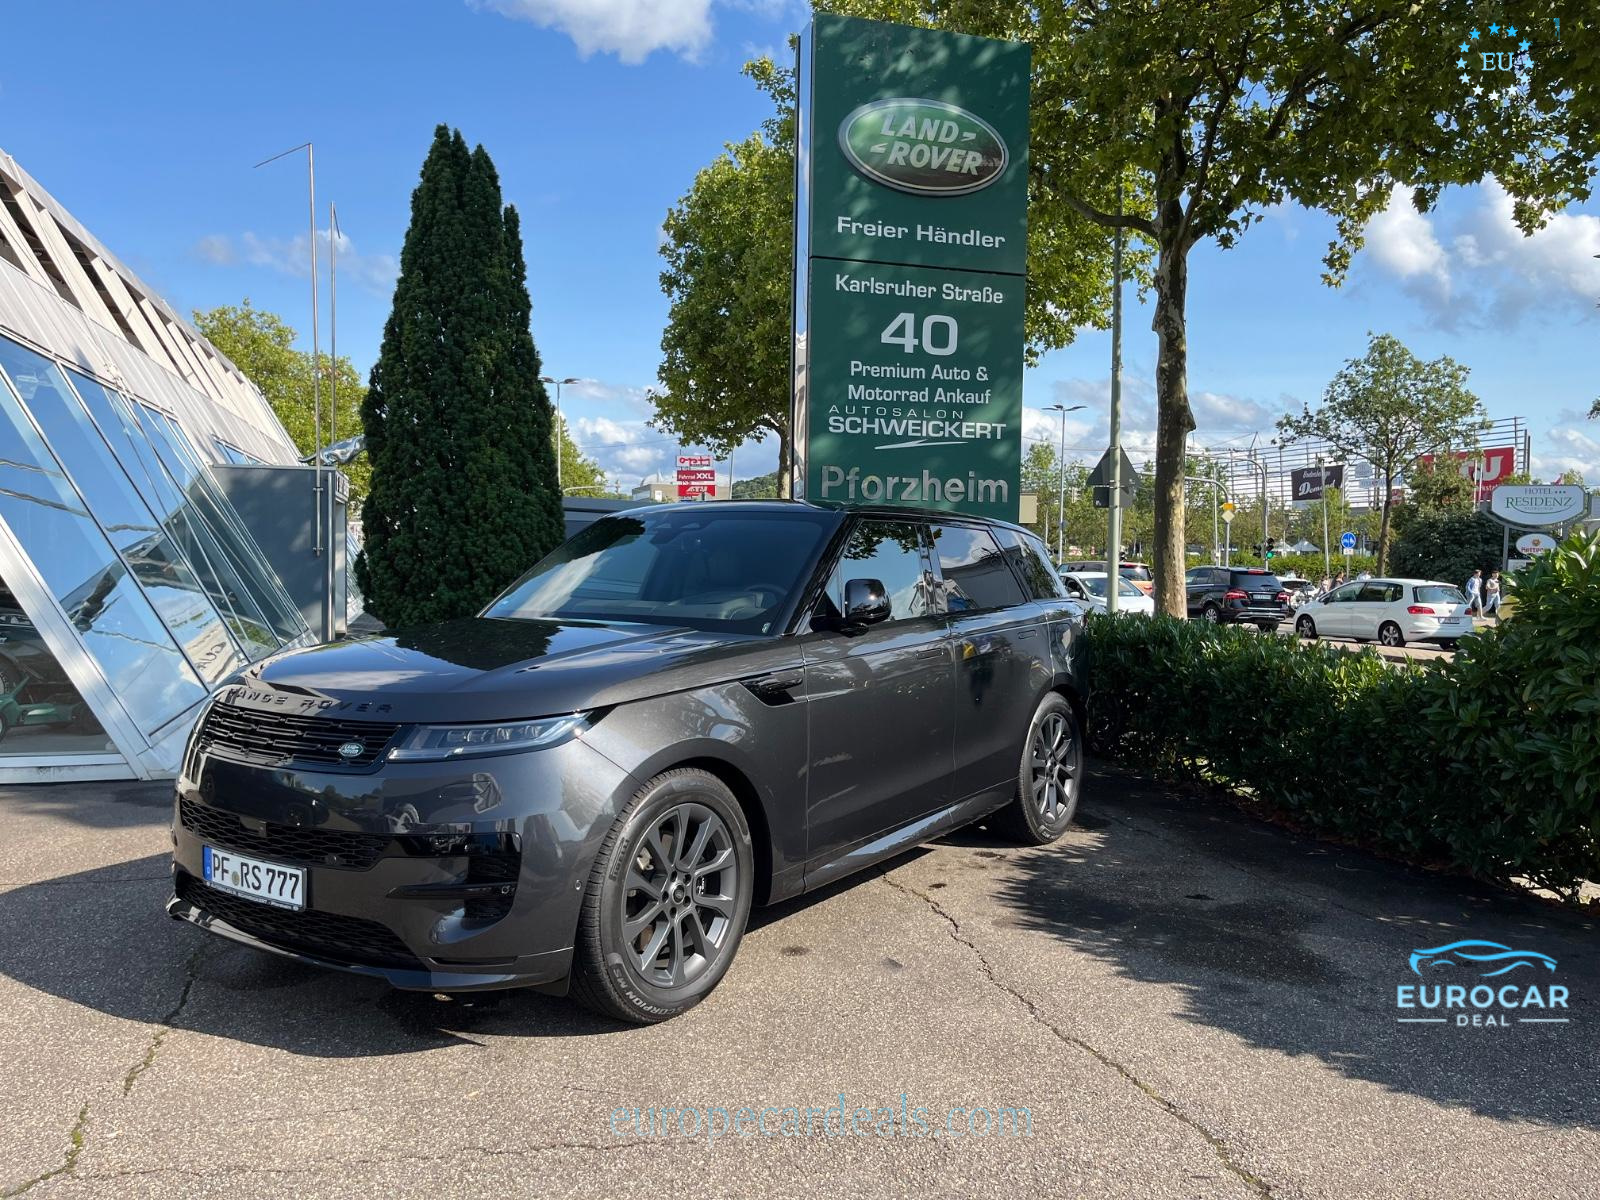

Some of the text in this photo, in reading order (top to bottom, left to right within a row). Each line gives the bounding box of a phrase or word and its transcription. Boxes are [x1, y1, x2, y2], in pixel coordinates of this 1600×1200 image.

[881, 113, 960, 144] LAND
[886, 140, 983, 176] ROVER
[837, 215, 1006, 248] Freier Händler
[835, 273, 1004, 304] Karlsruher Straße
[880, 312, 959, 356] 40
[850, 360, 989, 381] Premium Auto &
[847, 384, 992, 405] Motorrad Ankauf
[828, 404, 964, 420] AUTOSALON
[828, 416, 1007, 440] SCHWEICKERT
[821, 465, 1009, 503] Pforzheim
[1524, 487, 1553, 495] HOTEL
[1504, 496, 1573, 509] RESIDENZ
[227, 687, 393, 714] RANGE ROVER
[212, 853, 230, 881] PF
[625, 991, 684, 1015] SCORPION
